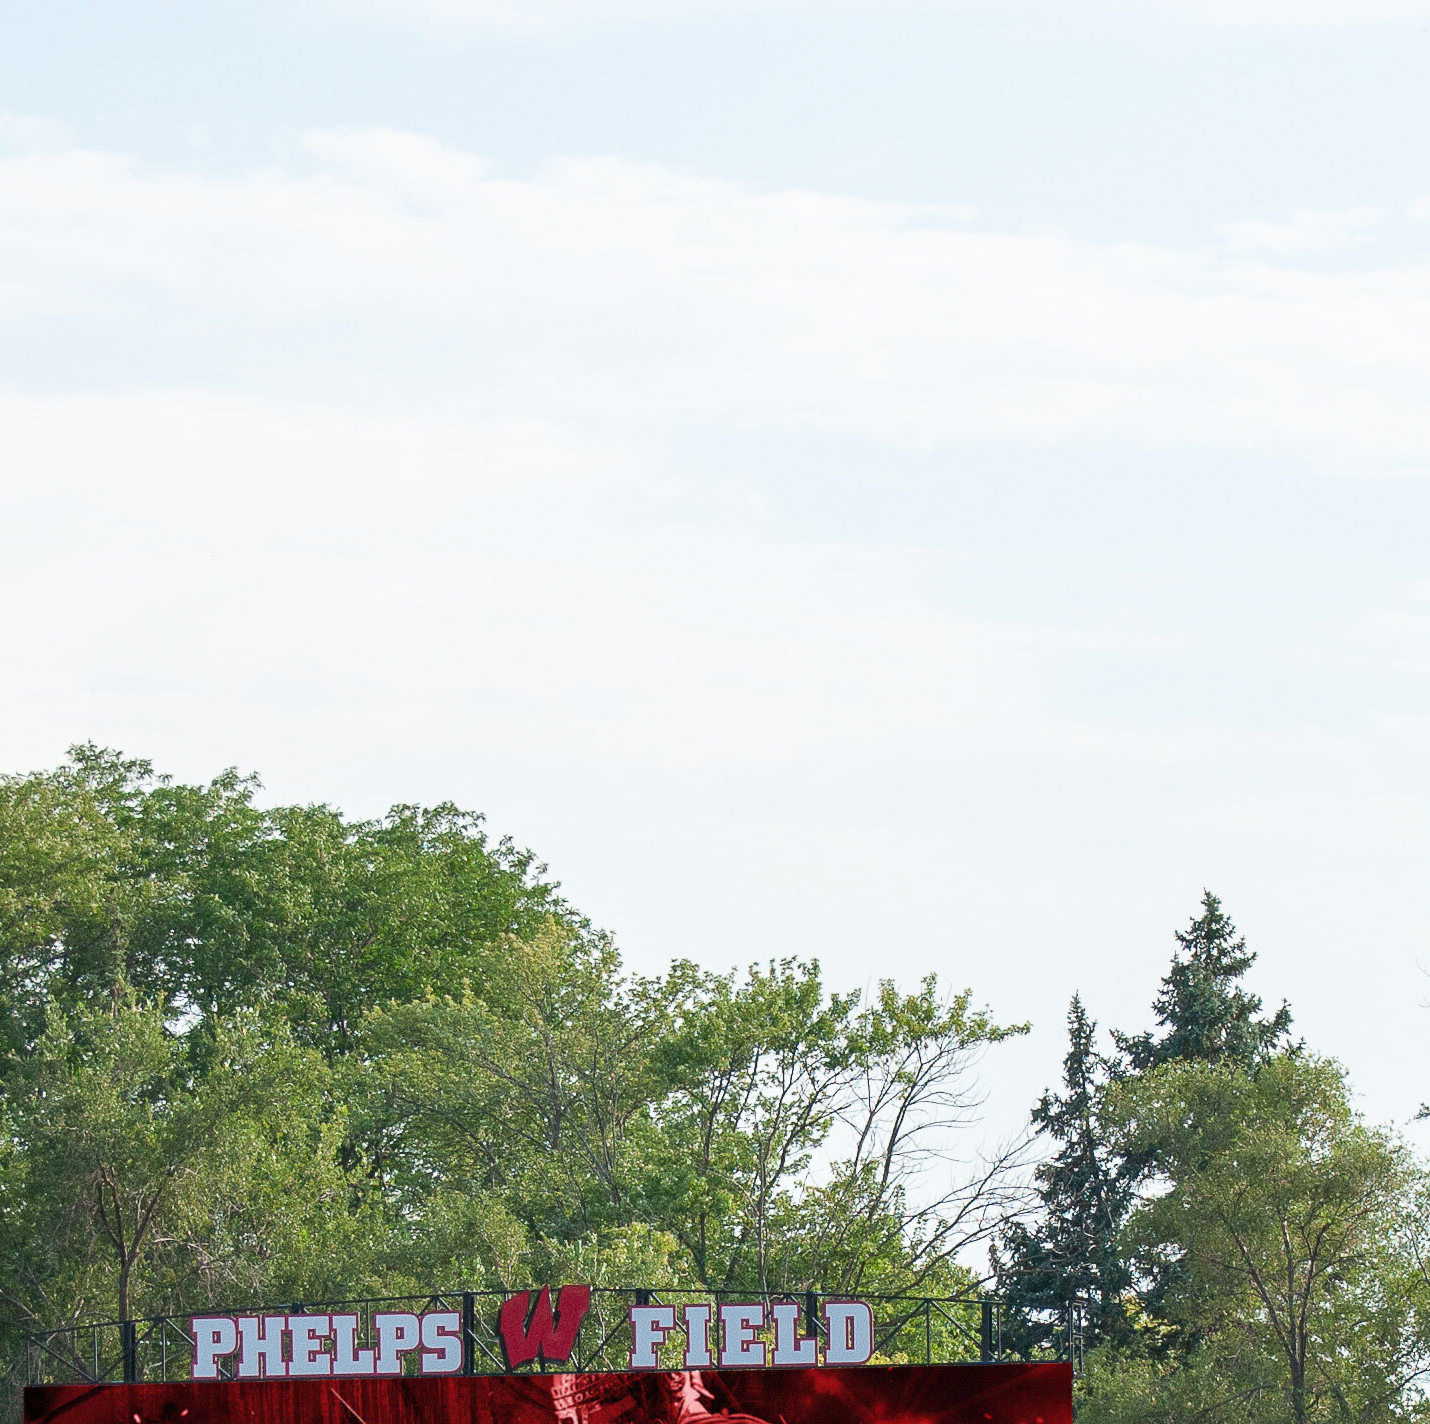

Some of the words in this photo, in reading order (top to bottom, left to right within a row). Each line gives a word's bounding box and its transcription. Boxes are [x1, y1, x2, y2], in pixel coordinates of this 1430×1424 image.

[190, 1310, 464, 1379] PHELPS
[497, 1284, 591, 1371] W
[628, 1299, 874, 1370] FIELD
